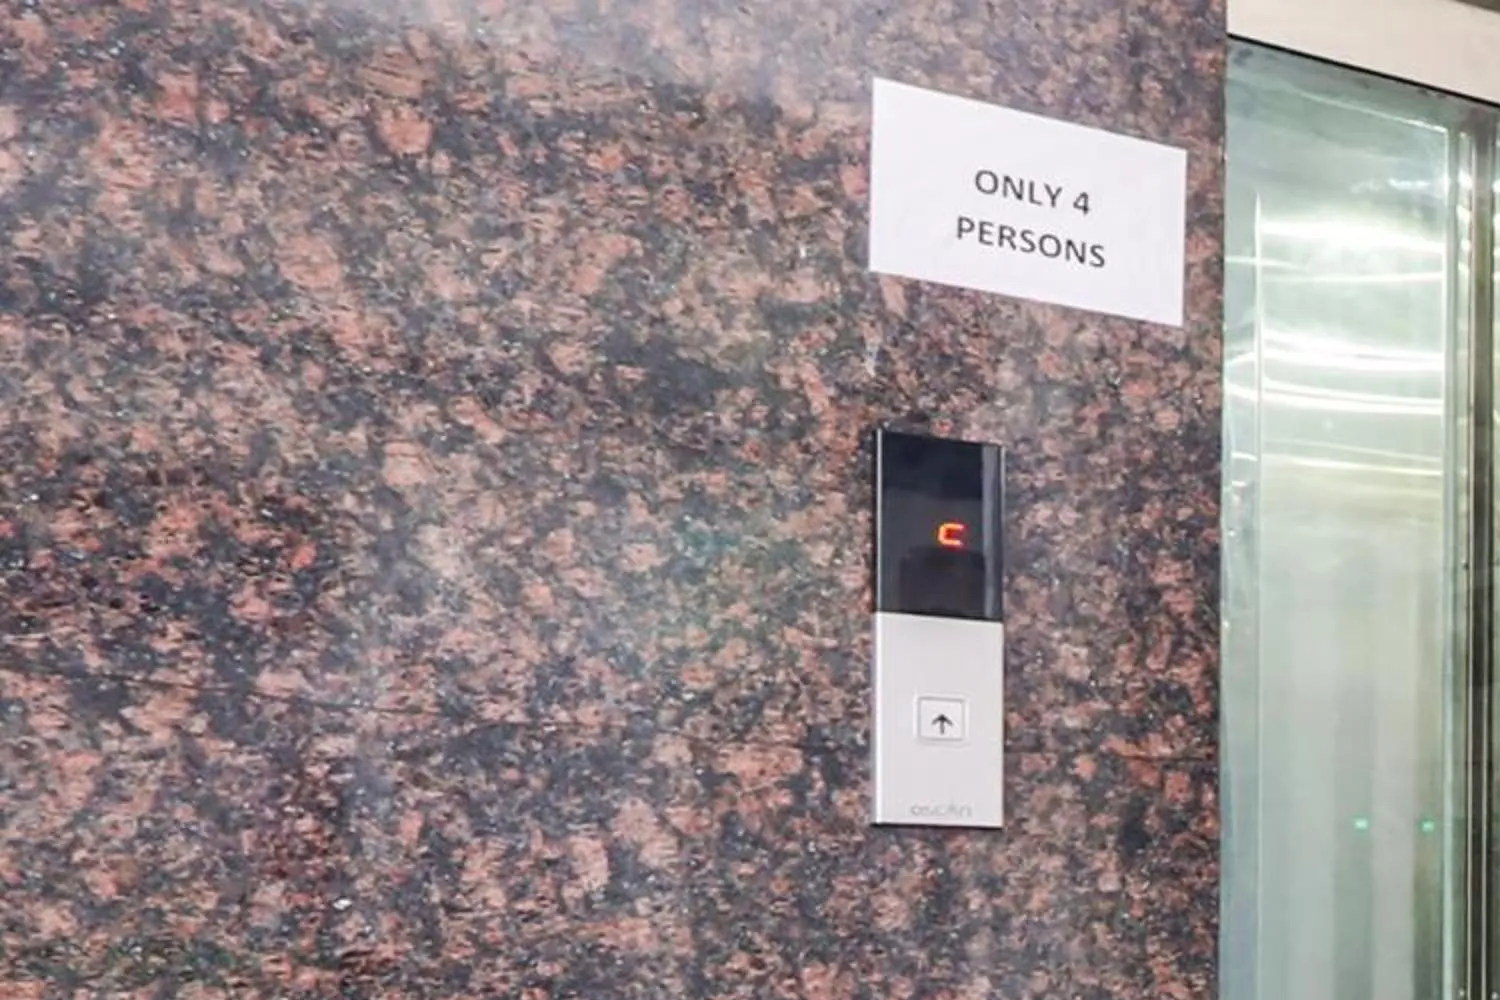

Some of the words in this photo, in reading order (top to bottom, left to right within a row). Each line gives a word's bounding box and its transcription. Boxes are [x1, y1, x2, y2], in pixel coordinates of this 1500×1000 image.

[974, 169, 1063, 208] ONLY
[1072, 191, 1091, 215] 4
[956, 215, 1106, 268] PERSONS
